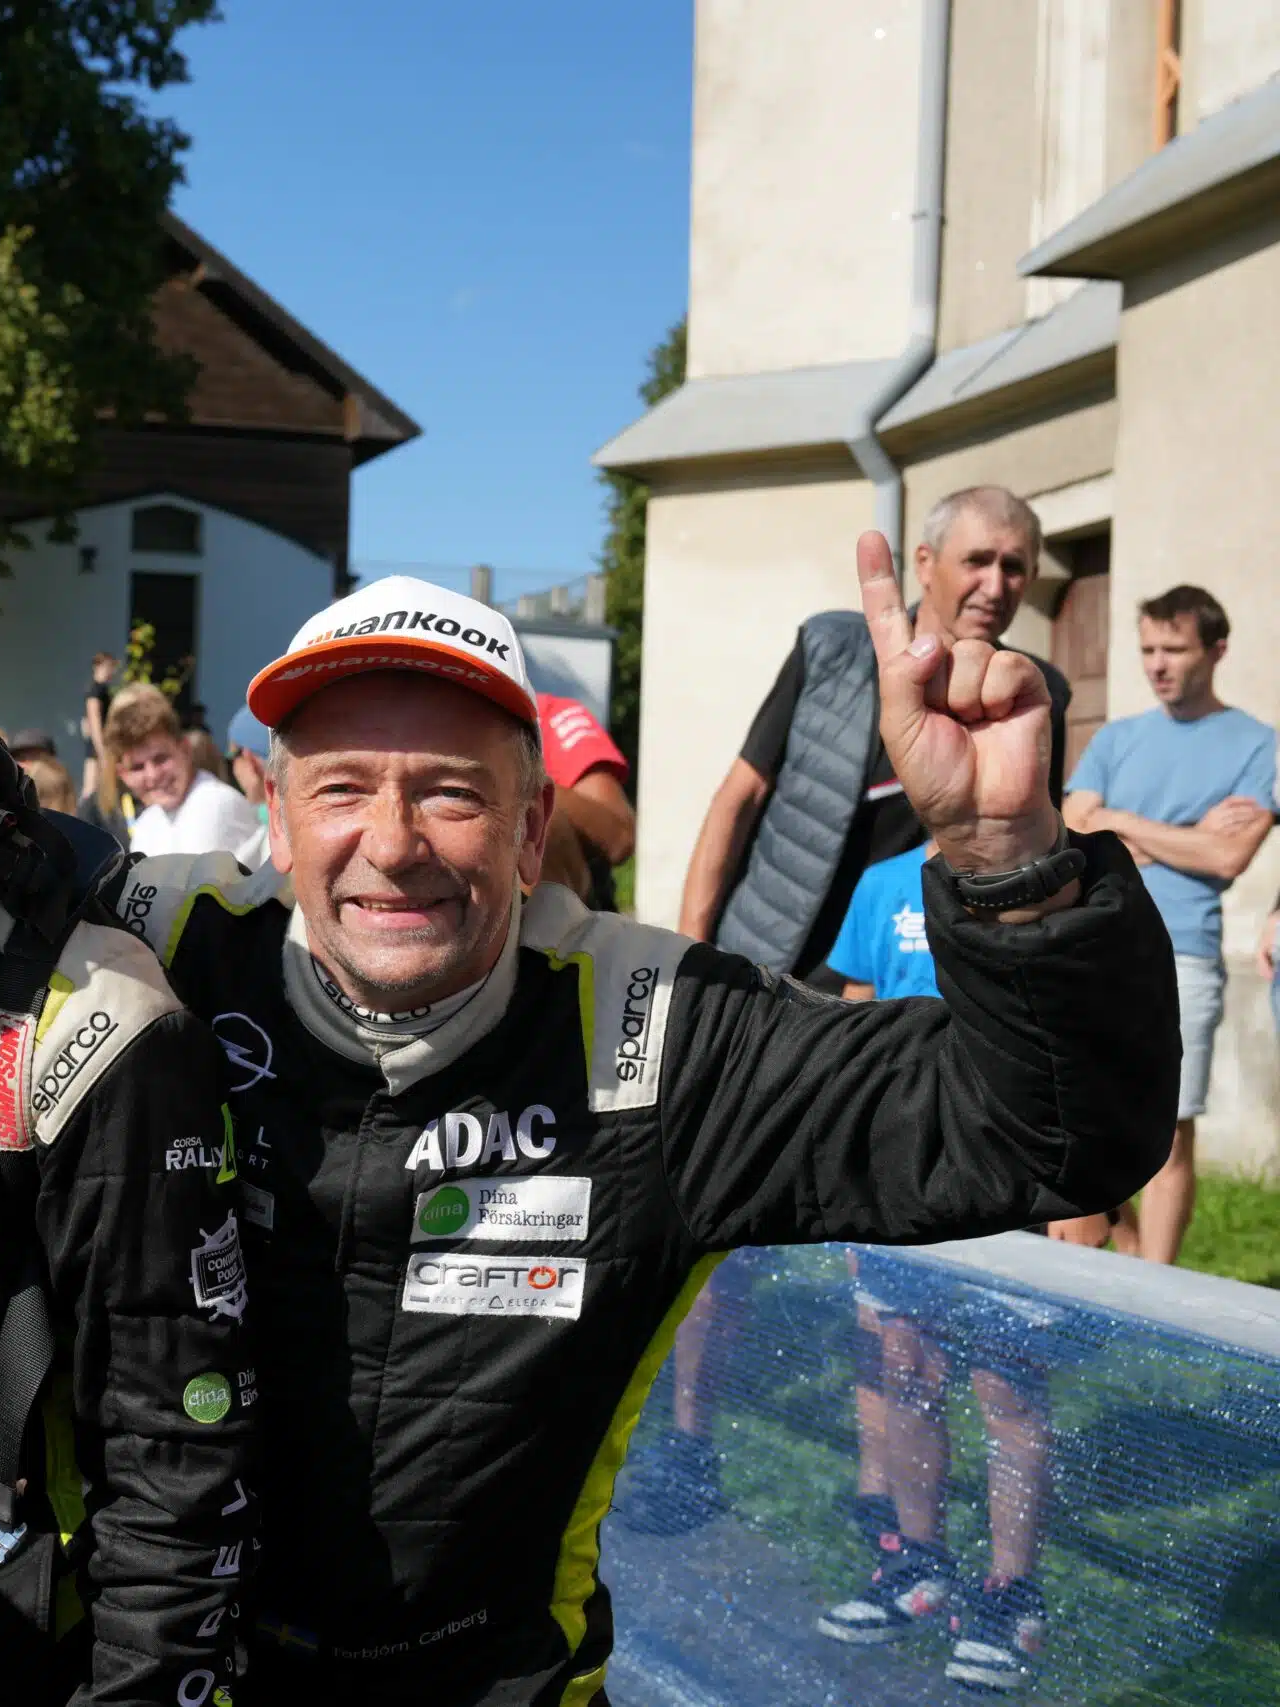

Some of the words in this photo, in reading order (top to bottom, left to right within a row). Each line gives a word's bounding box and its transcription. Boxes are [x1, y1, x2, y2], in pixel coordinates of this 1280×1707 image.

[616, 966, 656, 1083] sparco
[32, 1011, 114, 1114] sparco
[173, 1136, 203, 1149] CORSA
[405, 1103, 558, 1173] ADAC
[478, 1188, 519, 1206] Dina
[423, 1201, 465, 1222] dina
[478, 1207, 584, 1231] Försäkringar
[507, 1297, 548, 1308] ELEDA
[419, 1607, 489, 1647] Carlberg
